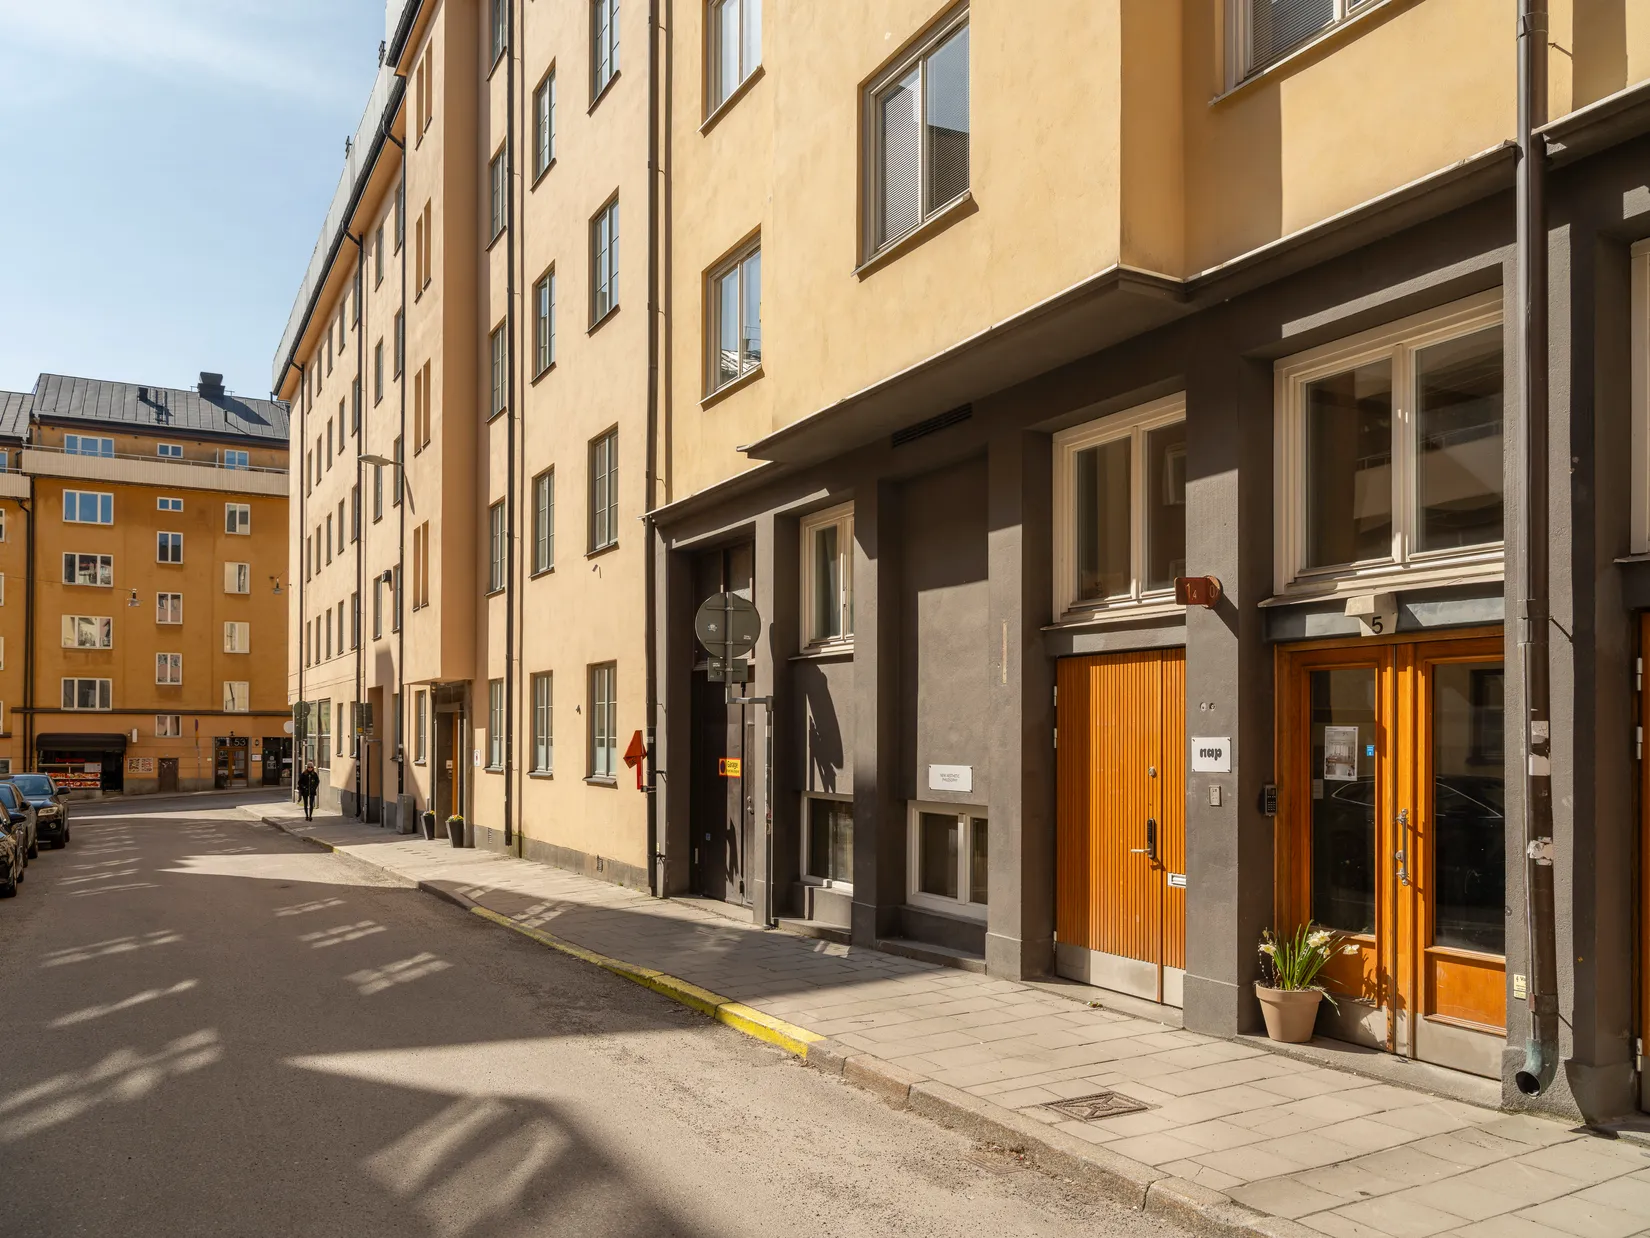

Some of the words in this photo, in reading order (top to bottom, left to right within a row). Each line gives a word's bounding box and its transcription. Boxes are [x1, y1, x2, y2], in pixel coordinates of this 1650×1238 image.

[1372, 616, 1383, 634] 5
[234, 738, 246, 747] 53
[1200, 748, 1222, 761] nap
